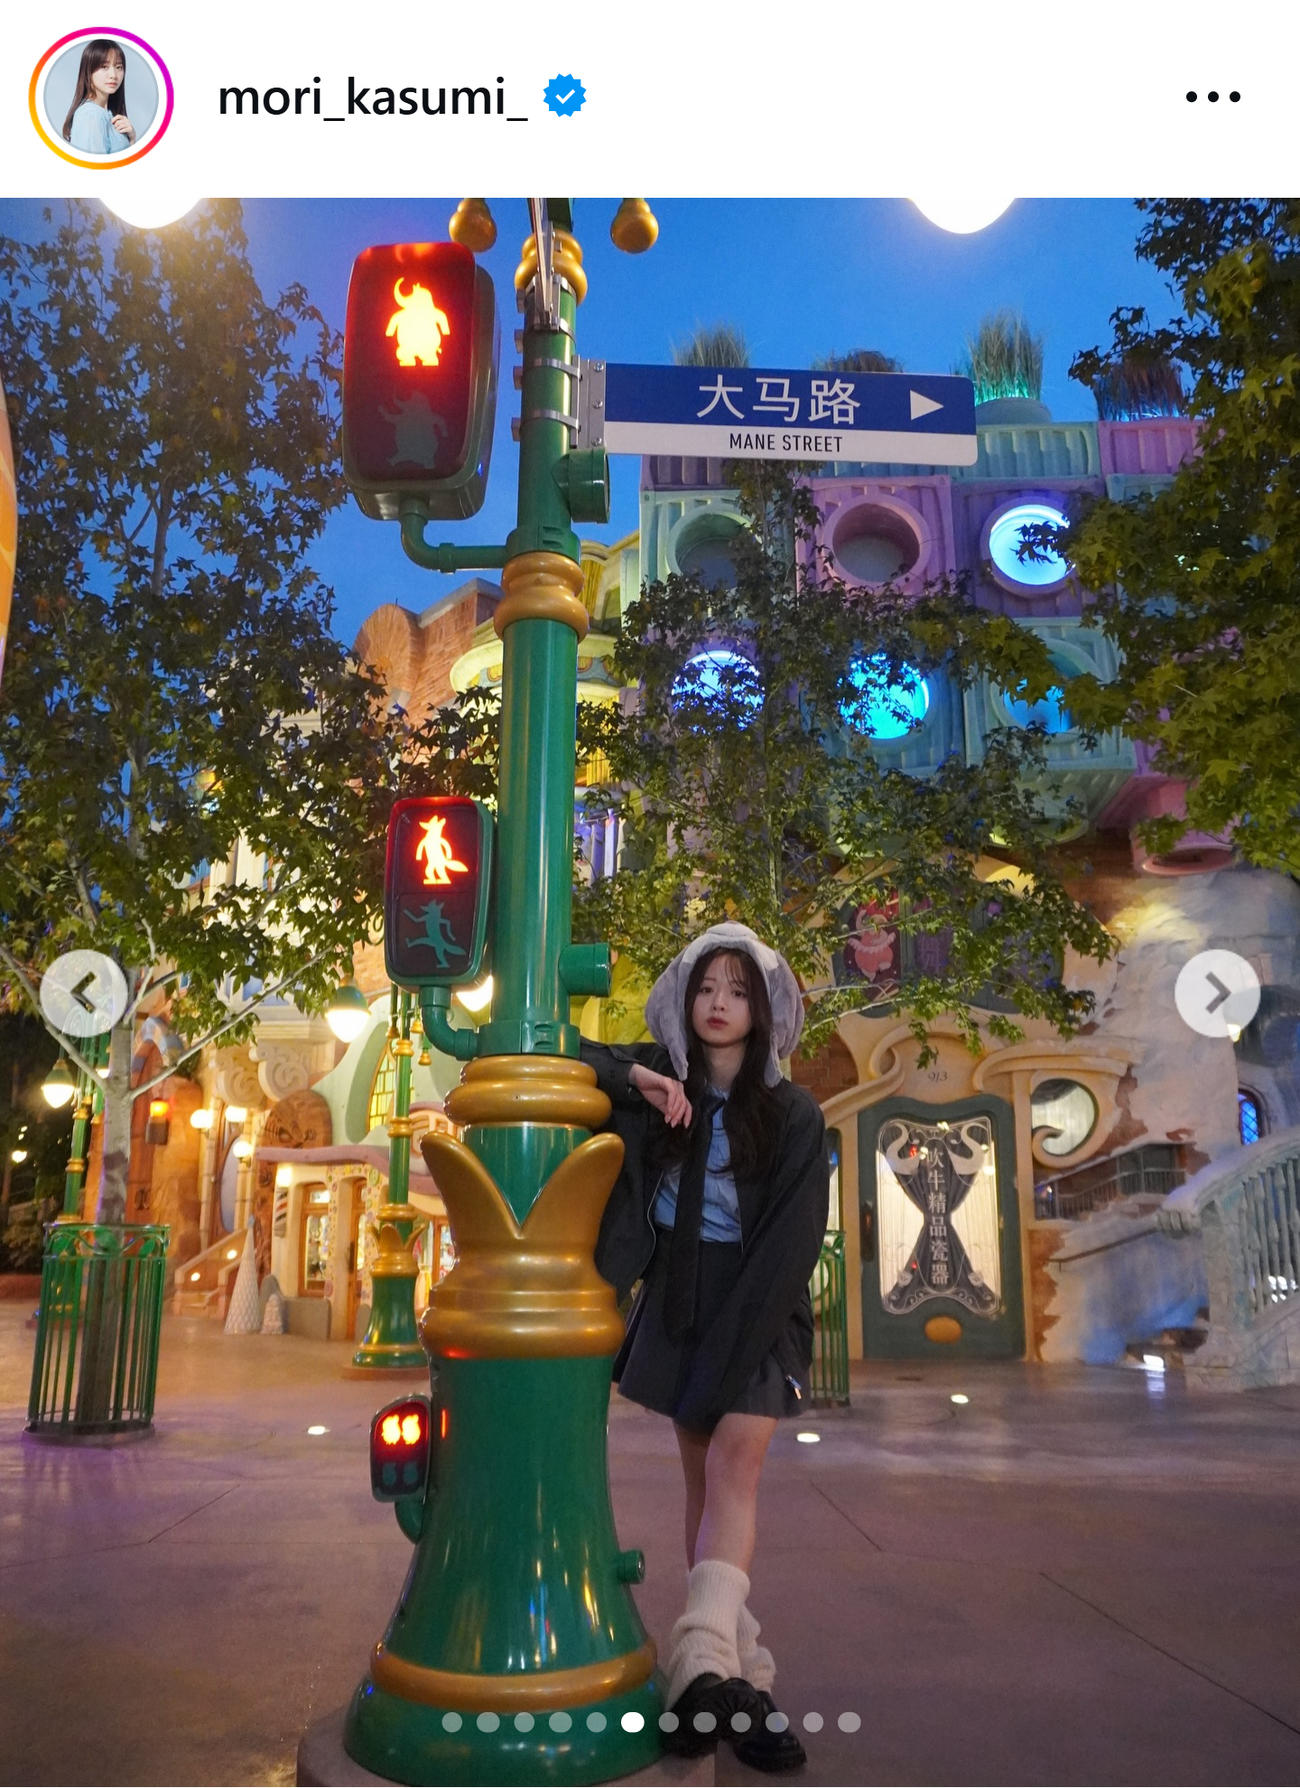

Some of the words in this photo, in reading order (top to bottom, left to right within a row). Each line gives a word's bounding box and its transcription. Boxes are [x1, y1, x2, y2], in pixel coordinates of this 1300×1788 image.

[697, 374, 860, 425] 大马路
[729, 433, 775, 451] MANE
[782, 435, 843, 453] STREET
[928, 1071, 948, 1083] 913
[928, 1147, 949, 1285] 吹牛精品瓷器
